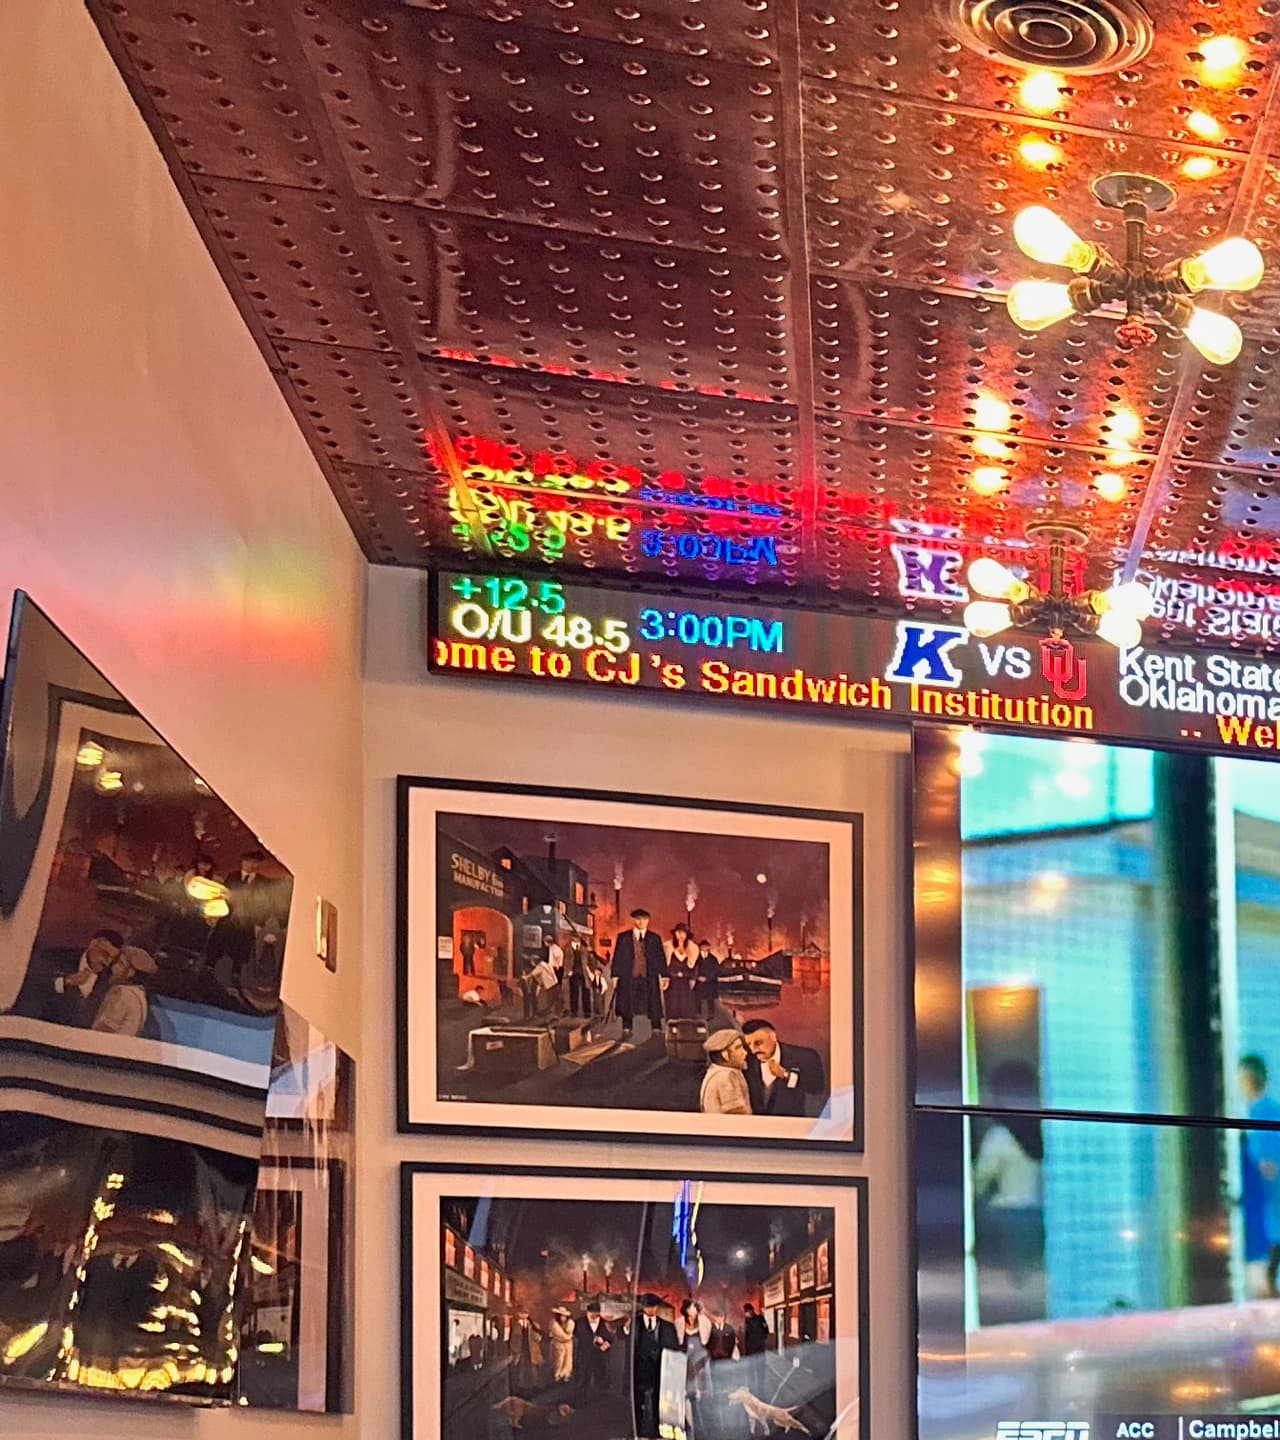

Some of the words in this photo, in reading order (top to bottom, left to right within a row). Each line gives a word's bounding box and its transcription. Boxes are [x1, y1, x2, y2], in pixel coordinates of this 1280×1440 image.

[452, 577, 566, 614] +12.5
[452, 602, 532, 643] O/U
[542, 615, 630, 653] 48.5
[639, 608, 783, 653] 3:00PM
[1119, 645, 1196, 683] Kent
[530, 646, 571, 678] to
[701, 660, 891, 710] Sandwich
[911, 683, 1093, 730] Institution
[451, 853, 491, 882] SHELBY
[1116, 1422, 1155, 1439] ACC
